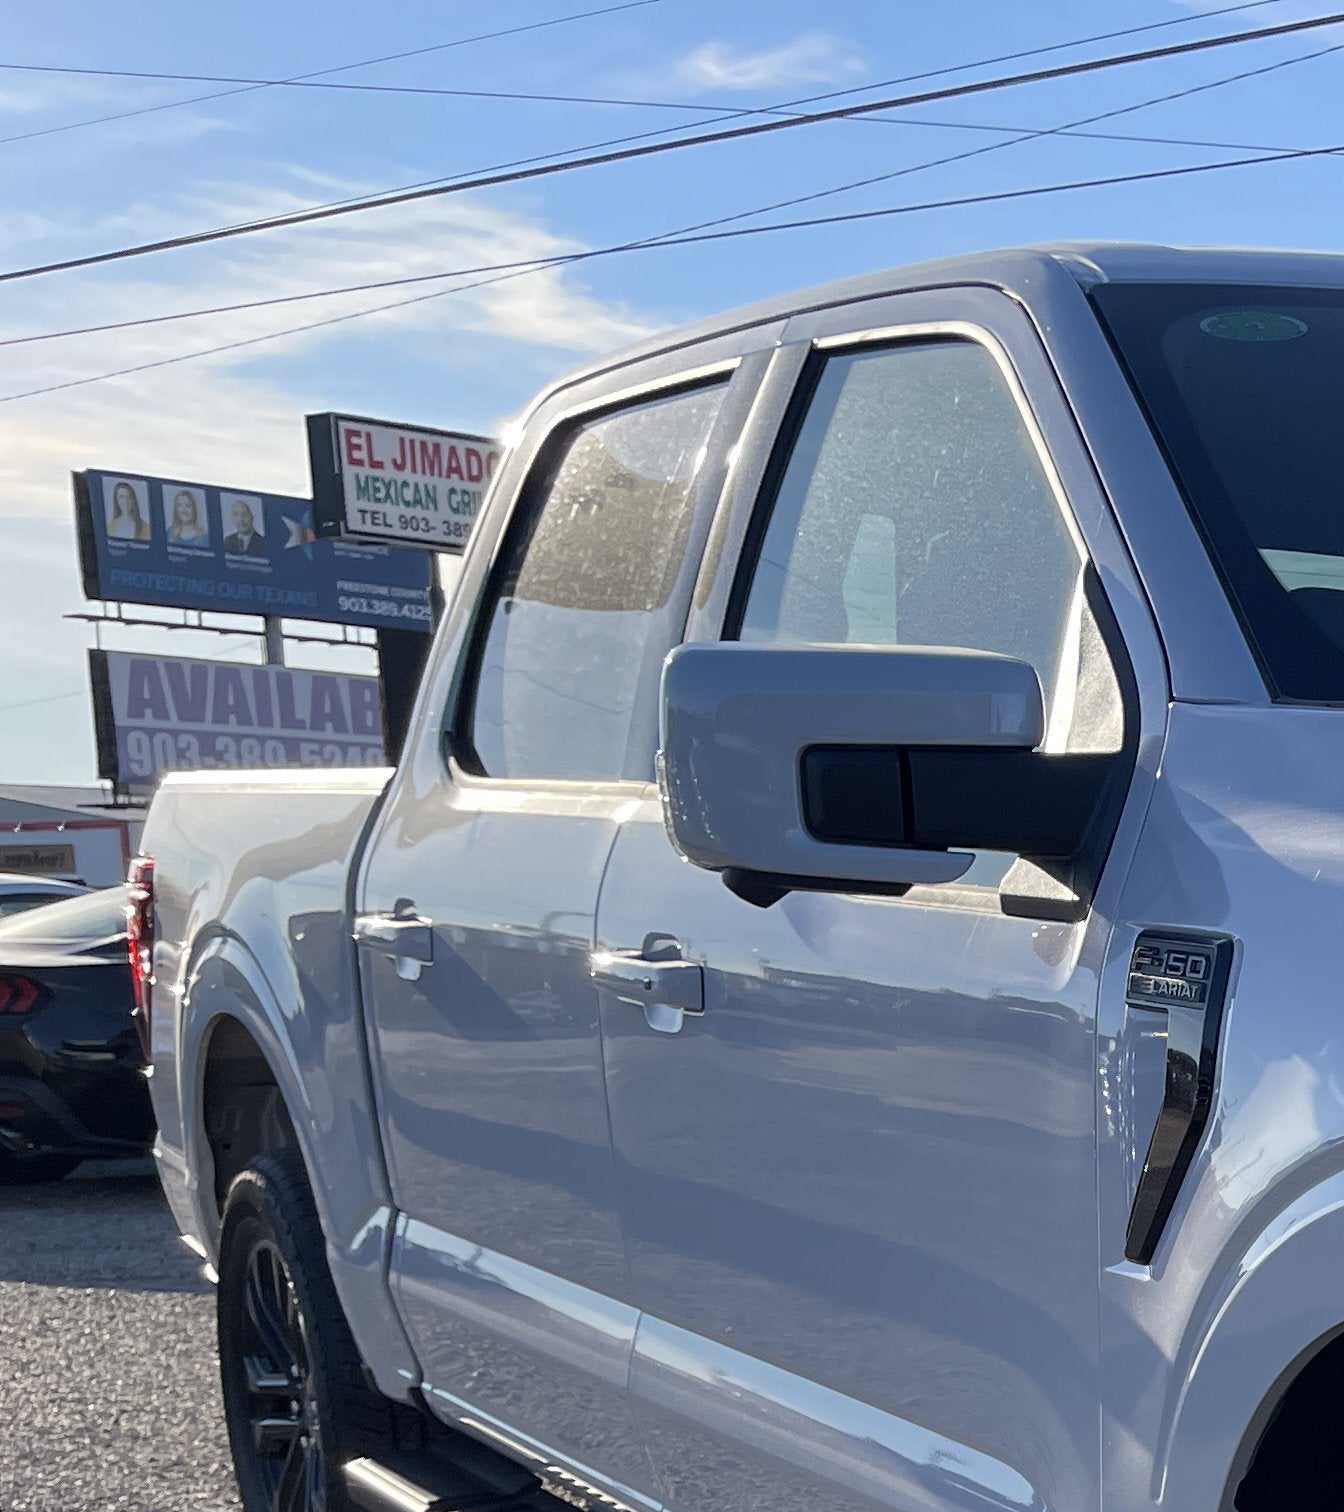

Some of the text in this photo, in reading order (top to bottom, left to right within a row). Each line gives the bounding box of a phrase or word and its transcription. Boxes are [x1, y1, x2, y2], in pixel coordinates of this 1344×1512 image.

[344, 428, 385, 469] EL
[355, 473, 438, 512] MEXICAN
[357, 509, 393, 529] TEL
[109, 568, 214, 596] PROTECTING
[218, 581, 254, 600] OUR
[127, 659, 382, 737] AVAILAB
[1131, 946, 1207, 979] F-150
[1146, 978, 1200, 1000] LARIAT
